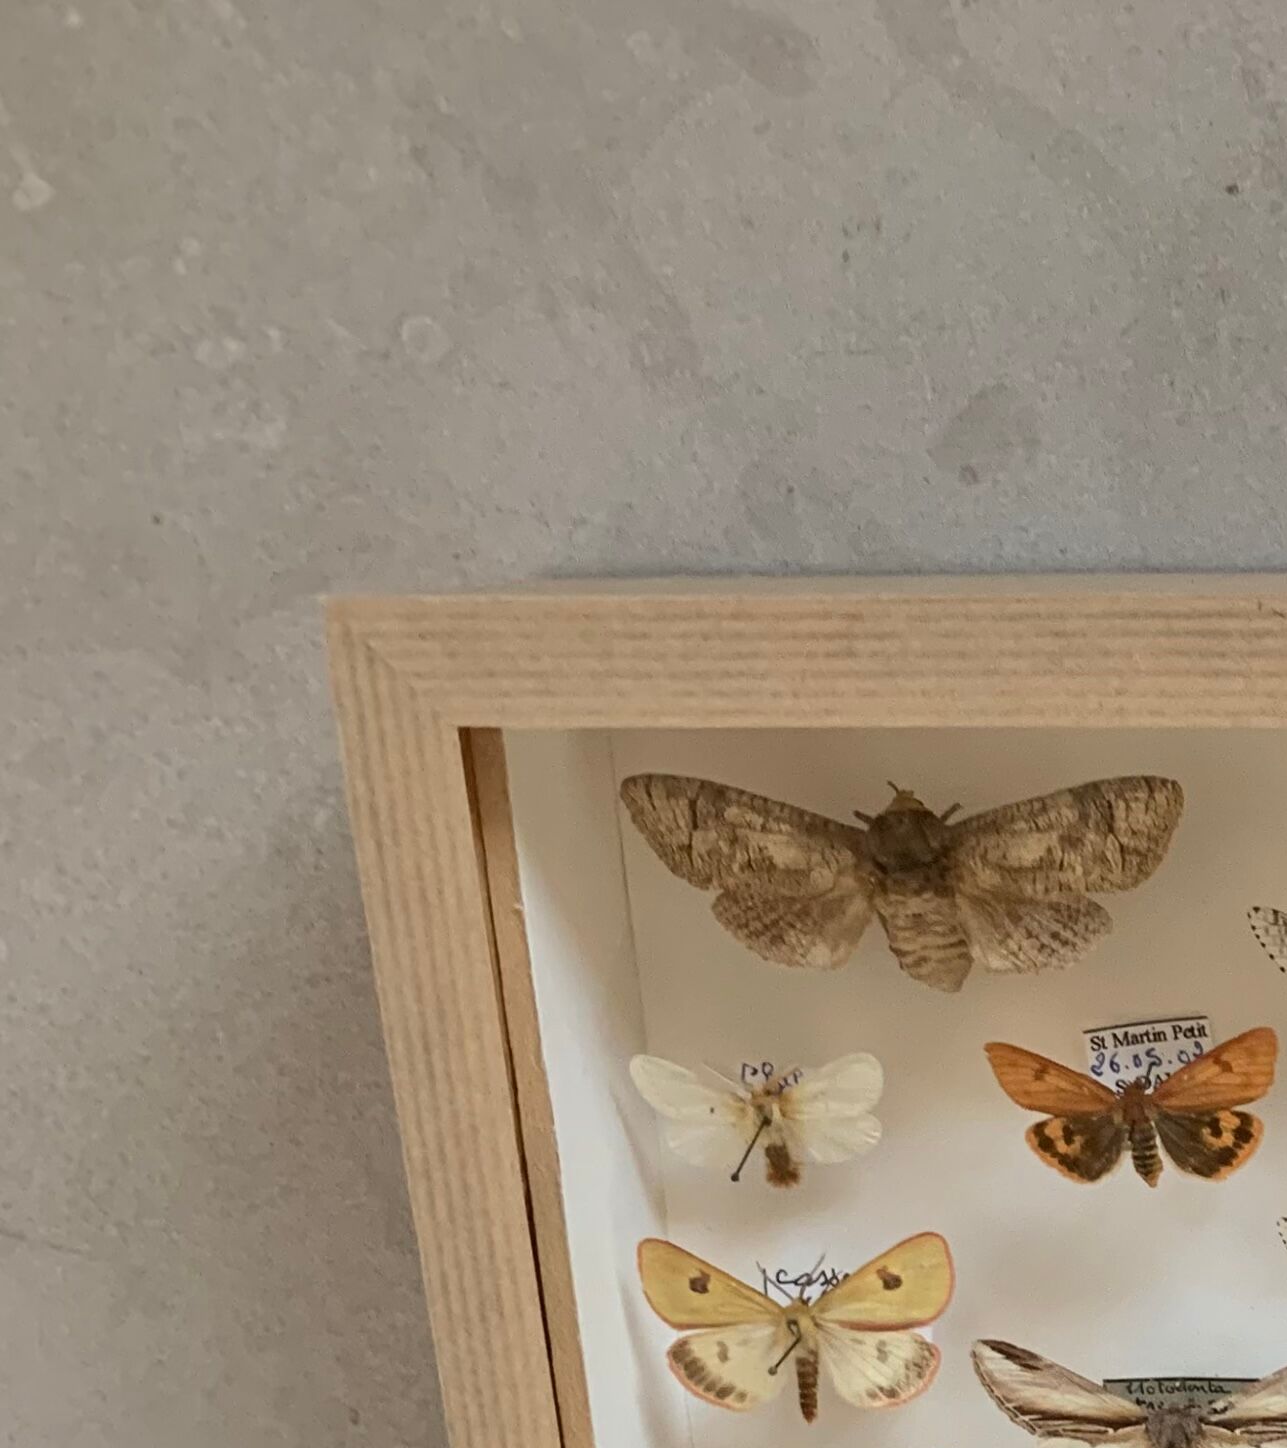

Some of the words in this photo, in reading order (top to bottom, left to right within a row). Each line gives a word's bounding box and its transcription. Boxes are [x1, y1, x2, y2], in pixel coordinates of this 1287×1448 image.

[1090, 1035, 1108, 1052] St
[1112, 1026, 1167, 1048] Martin
[1172, 1023, 1208, 1040] Petit
